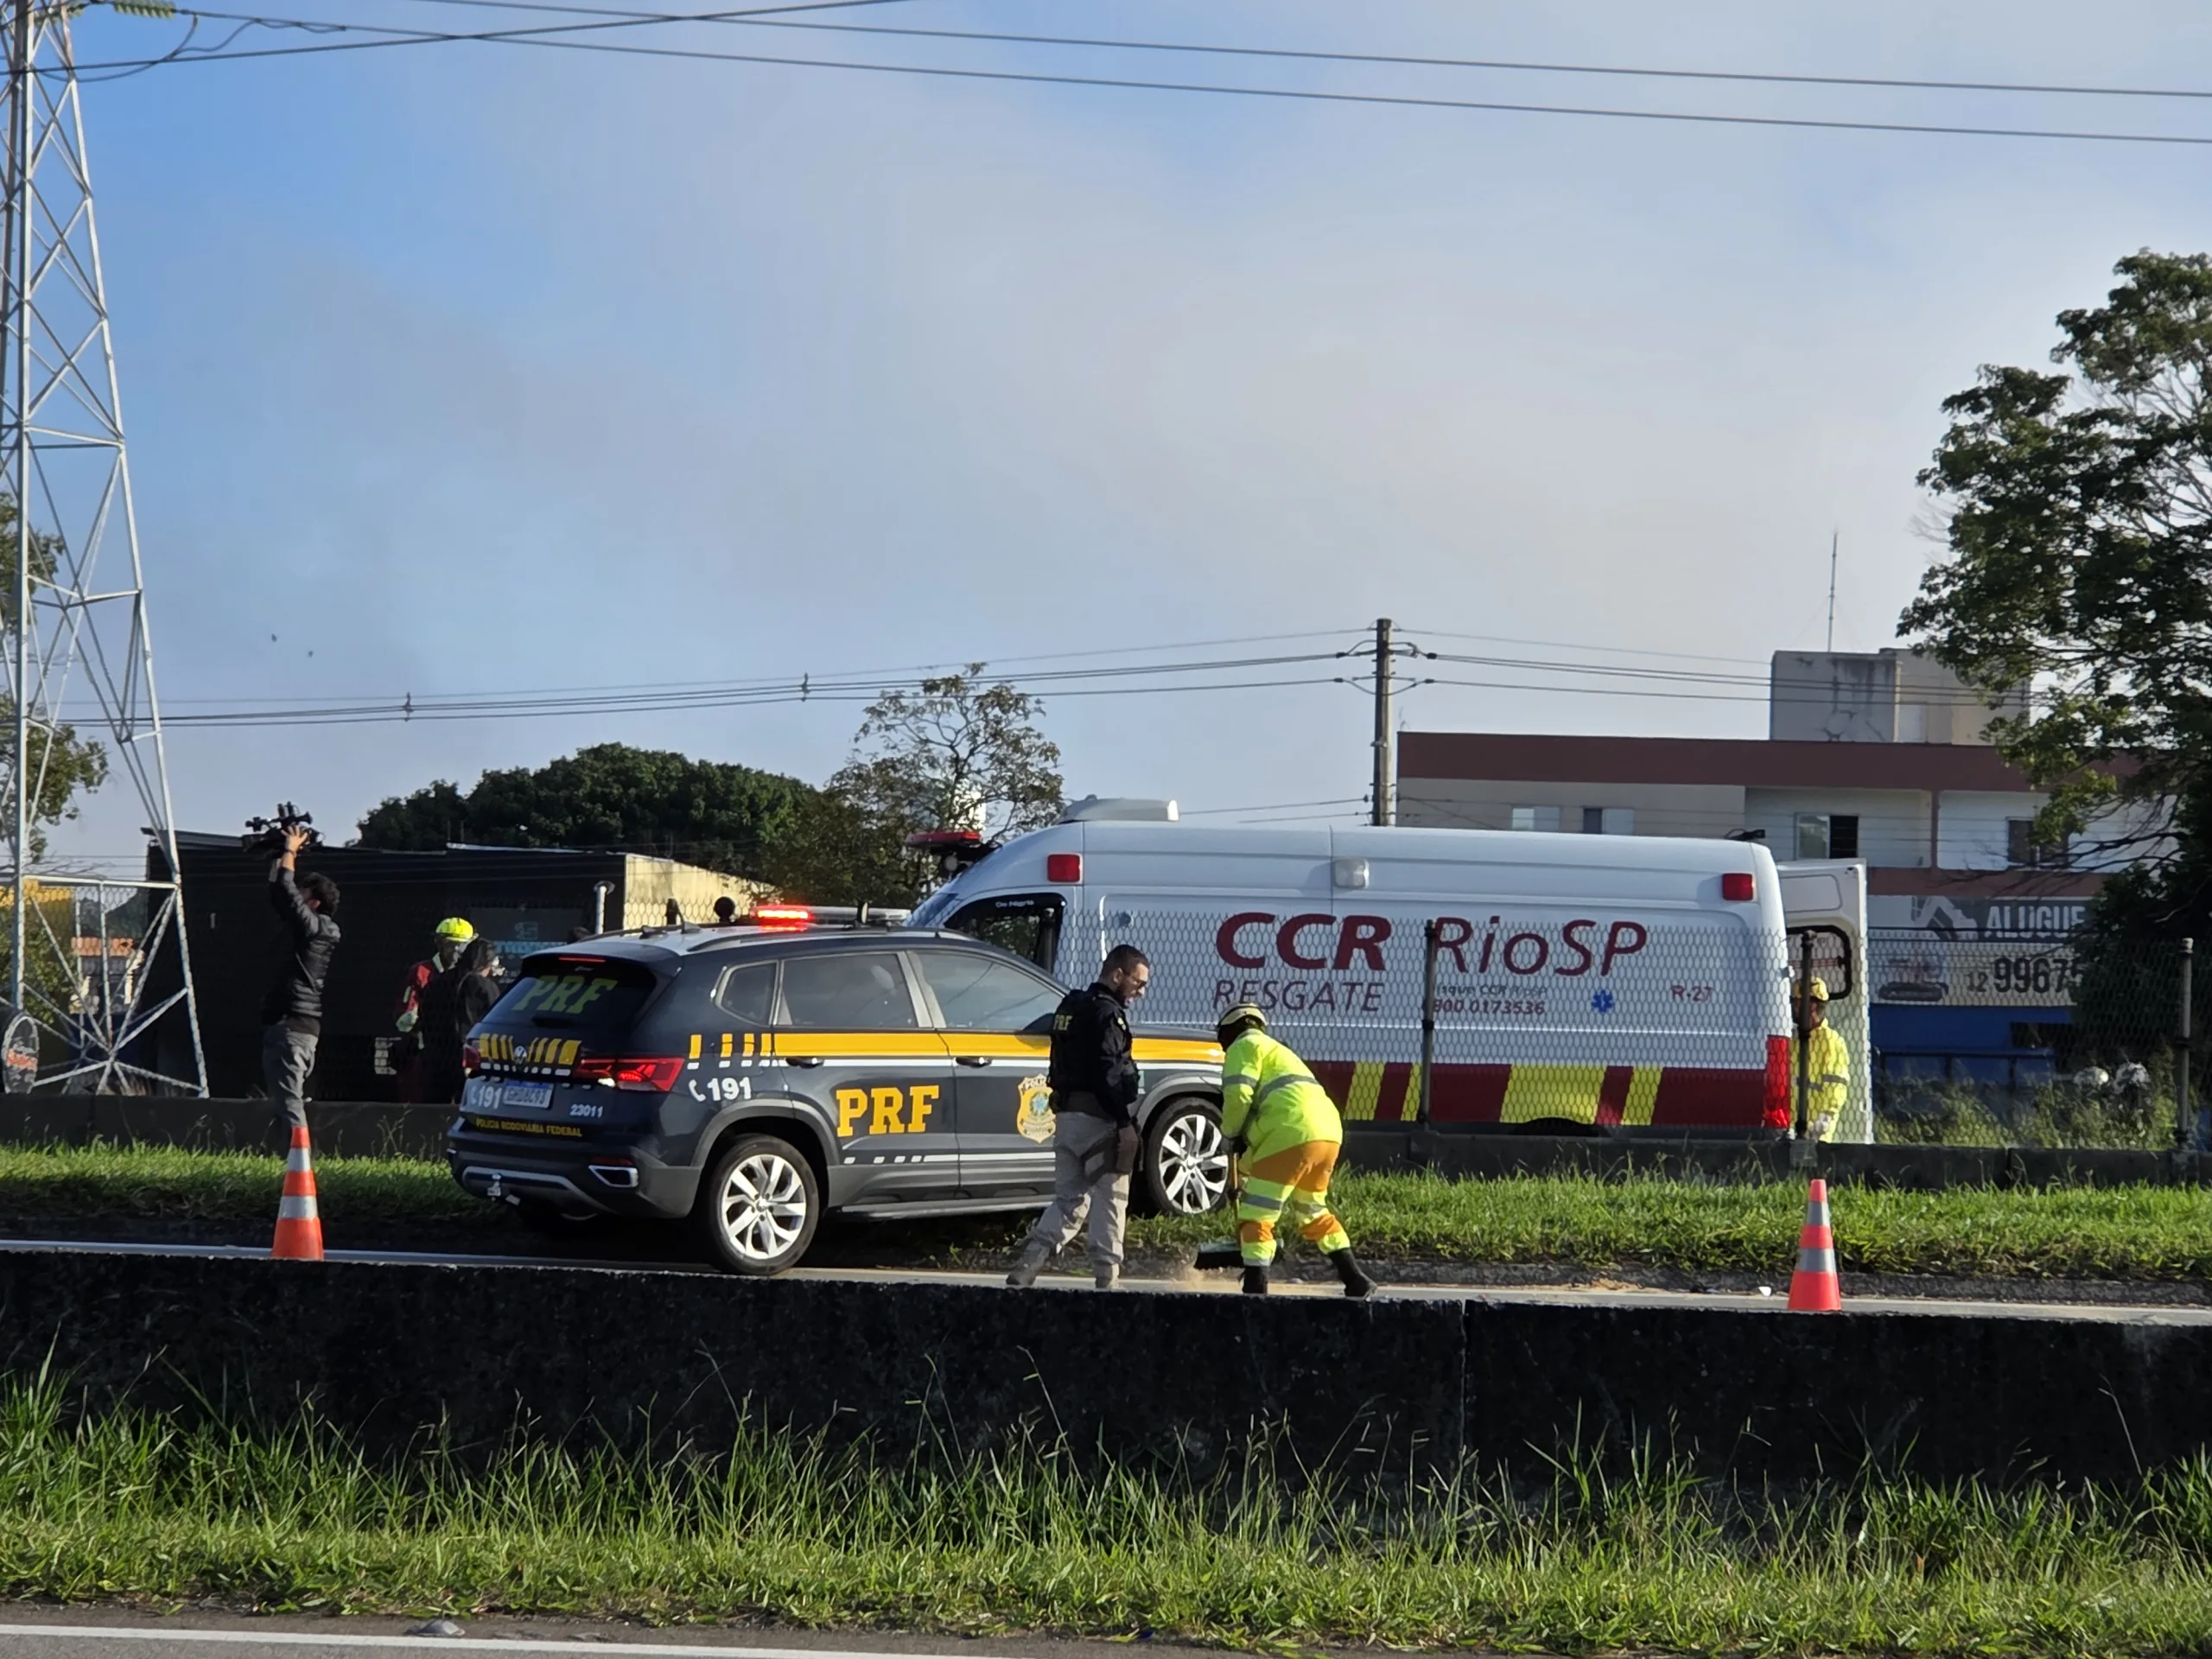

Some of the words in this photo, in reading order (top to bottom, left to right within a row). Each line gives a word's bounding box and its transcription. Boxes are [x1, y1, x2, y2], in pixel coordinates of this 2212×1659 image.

[1216, 912, 1392, 971] CCR
[1433, 915, 1647, 976] RioSP
[1967, 971, 1987, 992] 12
[512, 976, 619, 1014] PRF
[1213, 979, 1385, 1012] RESGATE
[1469, 999, 1546, 1015] 0173536
[1052, 1014, 1073, 1031] PRF
[478, 1085, 502, 1109] 191
[707, 1077, 752, 1101] 191
[569, 1103, 604, 1118] 23011
[836, 1085, 939, 1137] PRF
[546, 1125, 582, 1137] FEDERAL
